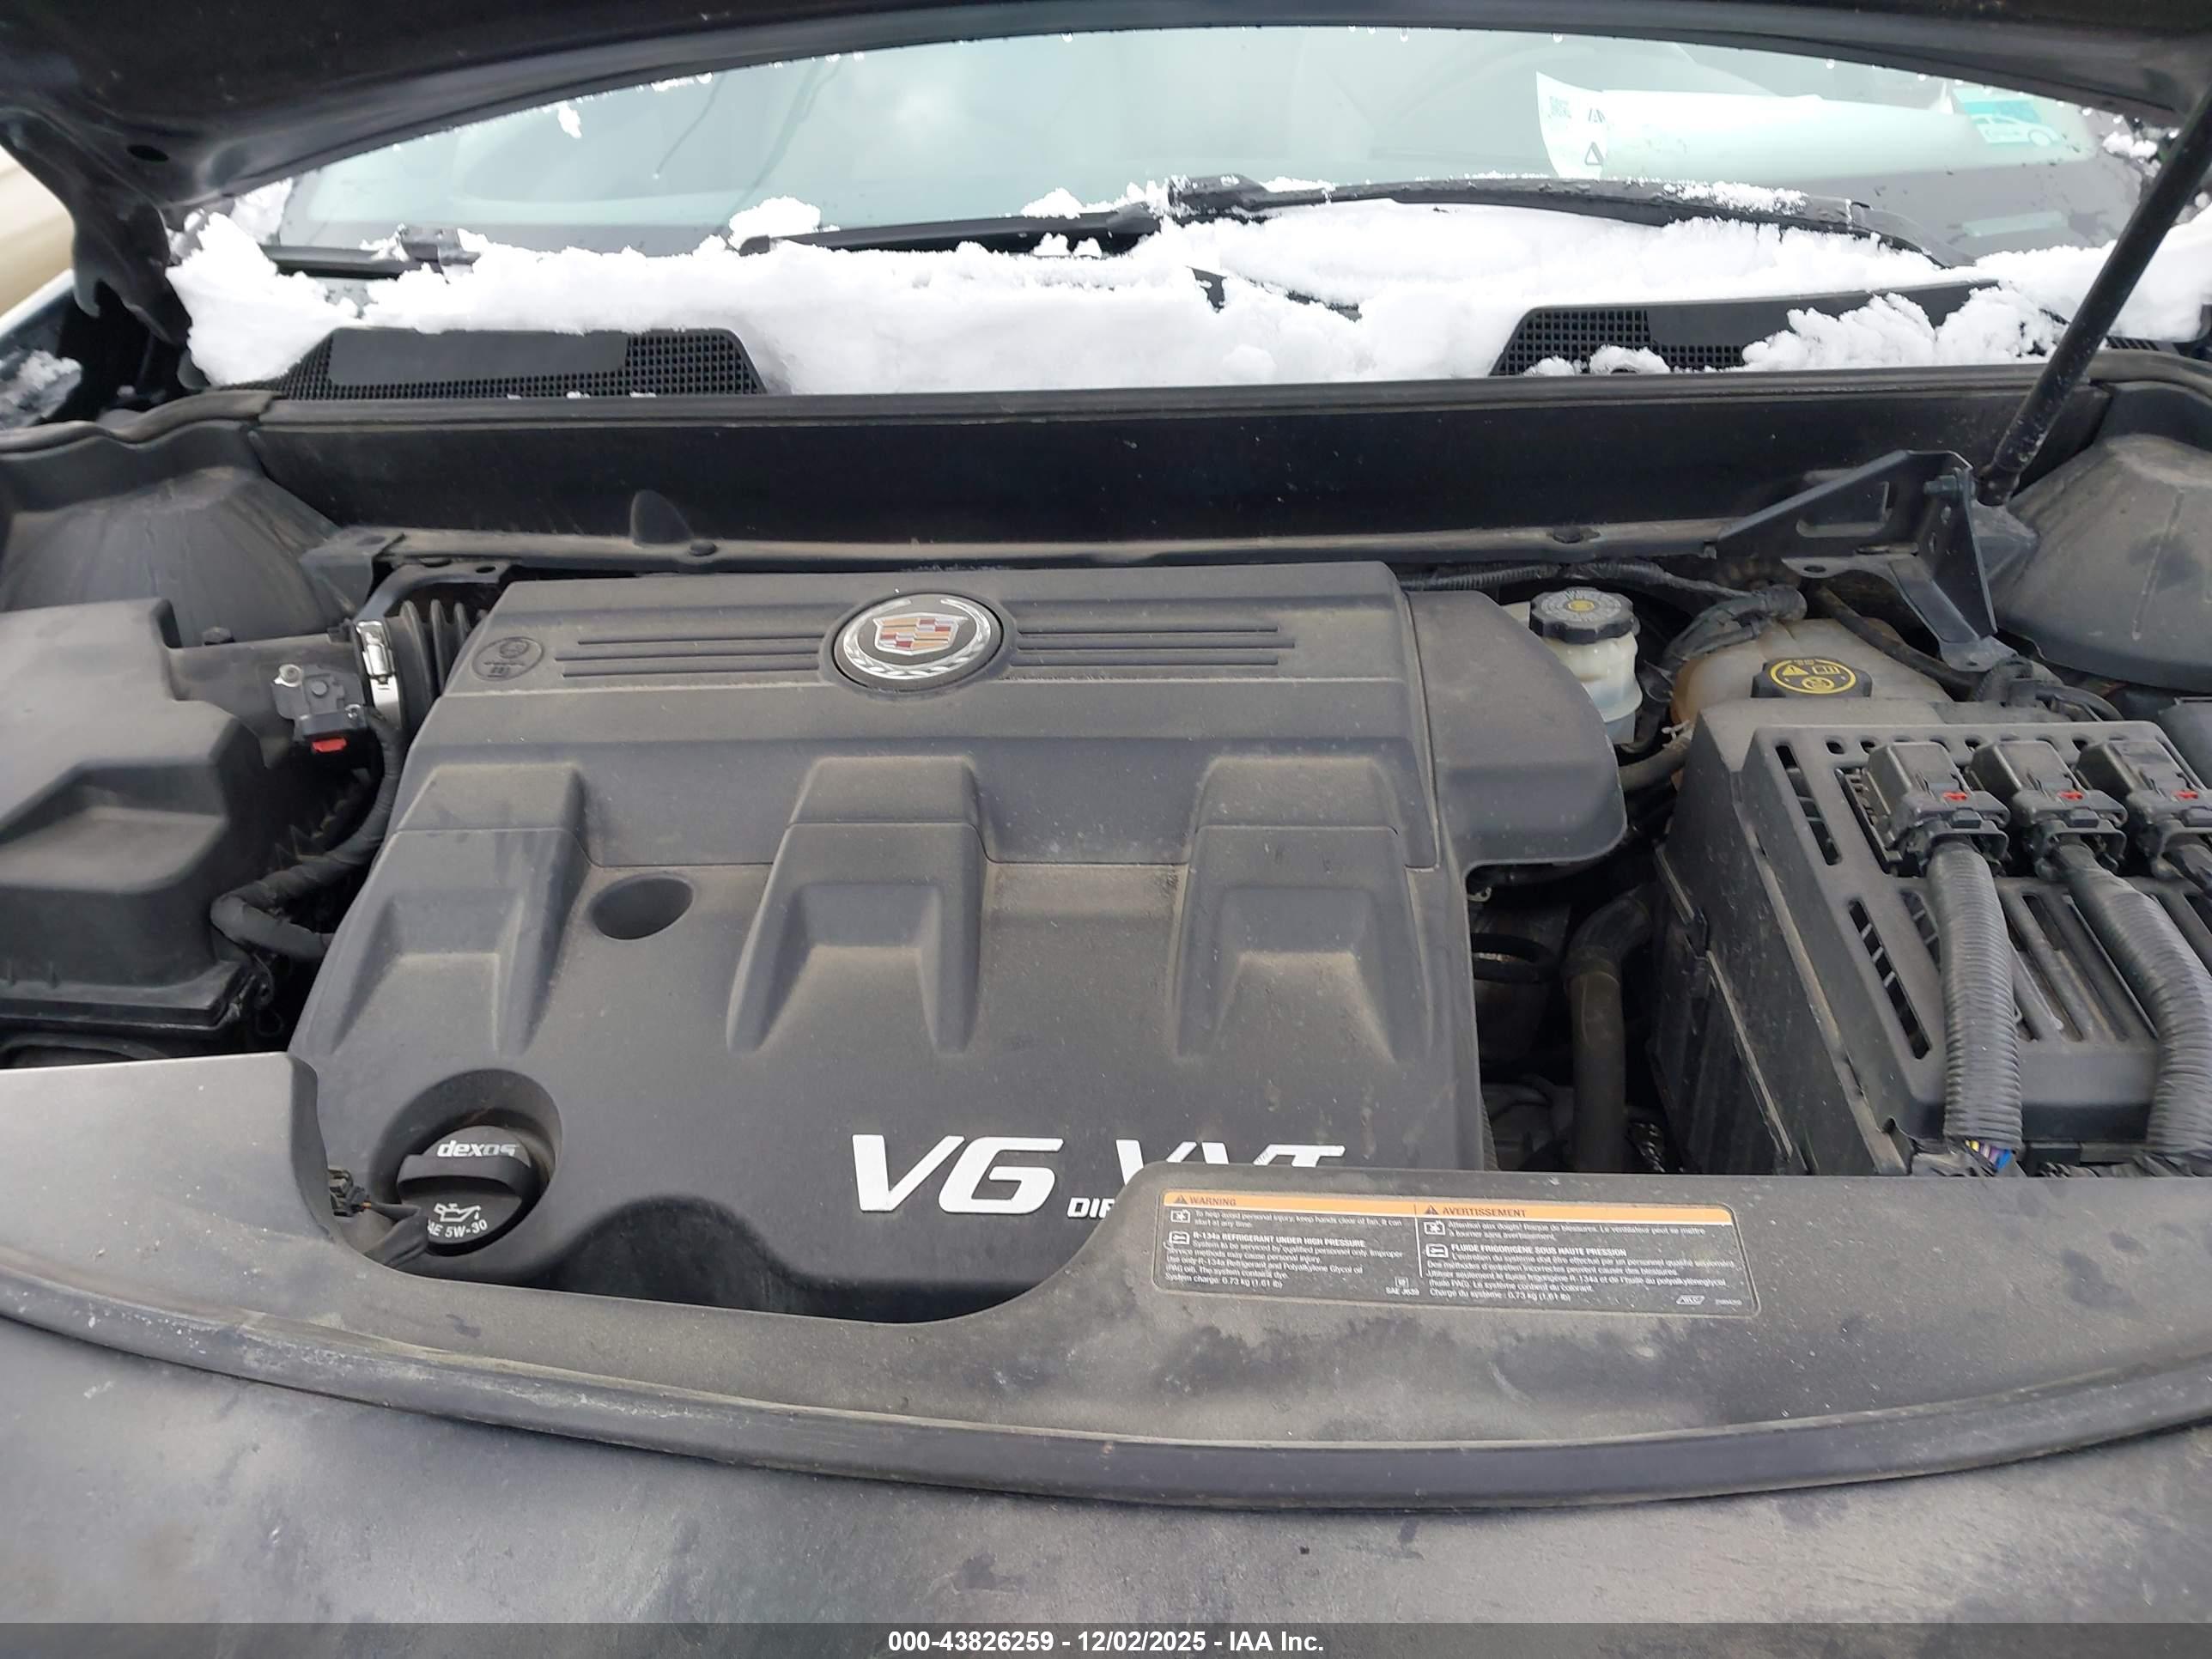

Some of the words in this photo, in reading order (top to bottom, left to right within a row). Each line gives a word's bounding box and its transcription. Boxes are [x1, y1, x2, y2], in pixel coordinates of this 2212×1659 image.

[437, 1139, 520, 1158] dexos
[853, 1133, 1063, 1214] V6
[1190, 1195, 1237, 1206] WARNING
[1205, 1210, 1220, 1218] help
[1242, 1212, 1272, 1221] personal
[1296, 1215, 1314, 1224] keep
[1315, 1215, 1337, 1224] hands
[1338, 1216, 1356, 1224] clear
[1443, 1207, 1527, 1218] AVERTISSEMENT
[427, 1220, 443, 1237] AE
[445, 1219, 488, 1238] 5W-30
[1448, 1220, 1481, 1230] Attention
[1482, 1222, 1497, 1231] aux
[1550, 1224, 1560, 1232] de
[1193, 1231, 1220, 1240] R-134a
[1222, 1233, 1274, 1243] REFRIGERANT
[1275, 1236, 1303, 1244] UNDER
[1304, 1237, 1323, 1245] HIGH
[1324, 1237, 1366, 1248] PRESSURE
[1192, 1240, 1219, 1249] System
[1240, 1243, 1271, 1251] serviced
[1272, 1244, 1281, 1253] by
[1282, 1246, 1313, 1255] qualified
[1314, 1248, 1351, 1256] personnel
[1370, 1249, 1403, 1258] Improper
[1194, 1249, 1226, 1257] methods
[1267, 1253, 1297, 1261] personal
[1450, 1243, 1479, 1253] FLUIDE
[1534, 1245, 1557, 1255] SOUS
[1558, 1246, 1584, 1255] HAUTE
[1586, 1248, 1626, 1257] PRESSION
[1167, 1255, 1181, 1263] Use
[1181, 1256, 1197, 1265] only
[1198, 1257, 1225, 1267] R-134a
[1226, 1258, 1267, 1269] Refrigerant
[1329, 1265, 1352, 1273] Glycol
[1213, 1267, 1240, 1276] system
[1241, 1269, 1272, 1278] contains
[1165, 1273, 1192, 1281] System
[1240, 1277, 1250, 1287] kg
[1430, 1289, 1457, 1298] Charge
[1527, 1292, 1538, 1302] kg
